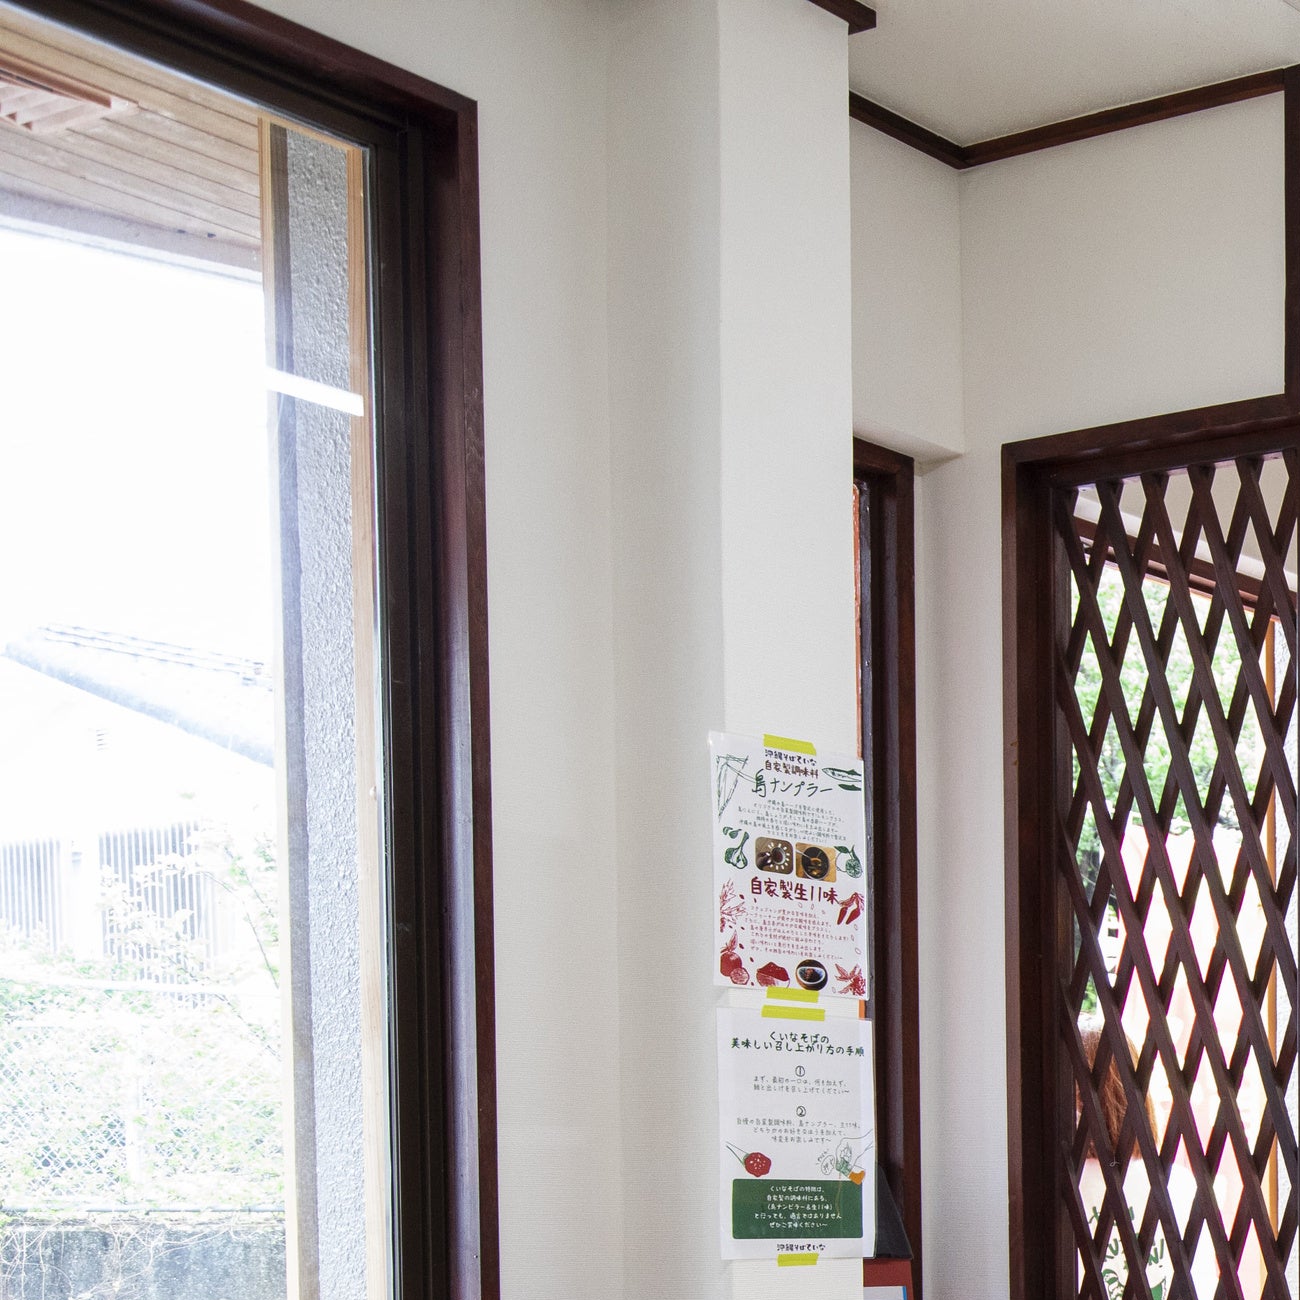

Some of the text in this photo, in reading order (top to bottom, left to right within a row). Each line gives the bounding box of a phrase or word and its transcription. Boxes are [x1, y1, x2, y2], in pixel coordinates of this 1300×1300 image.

[765, 760, 818, 779] 自家製調味料
[752, 768, 833, 798] 島ナンプラー
[731, 1037, 864, 1056] 美味しい召し上がり方の手順
[770, 1031, 830, 1044] くいなそばの
